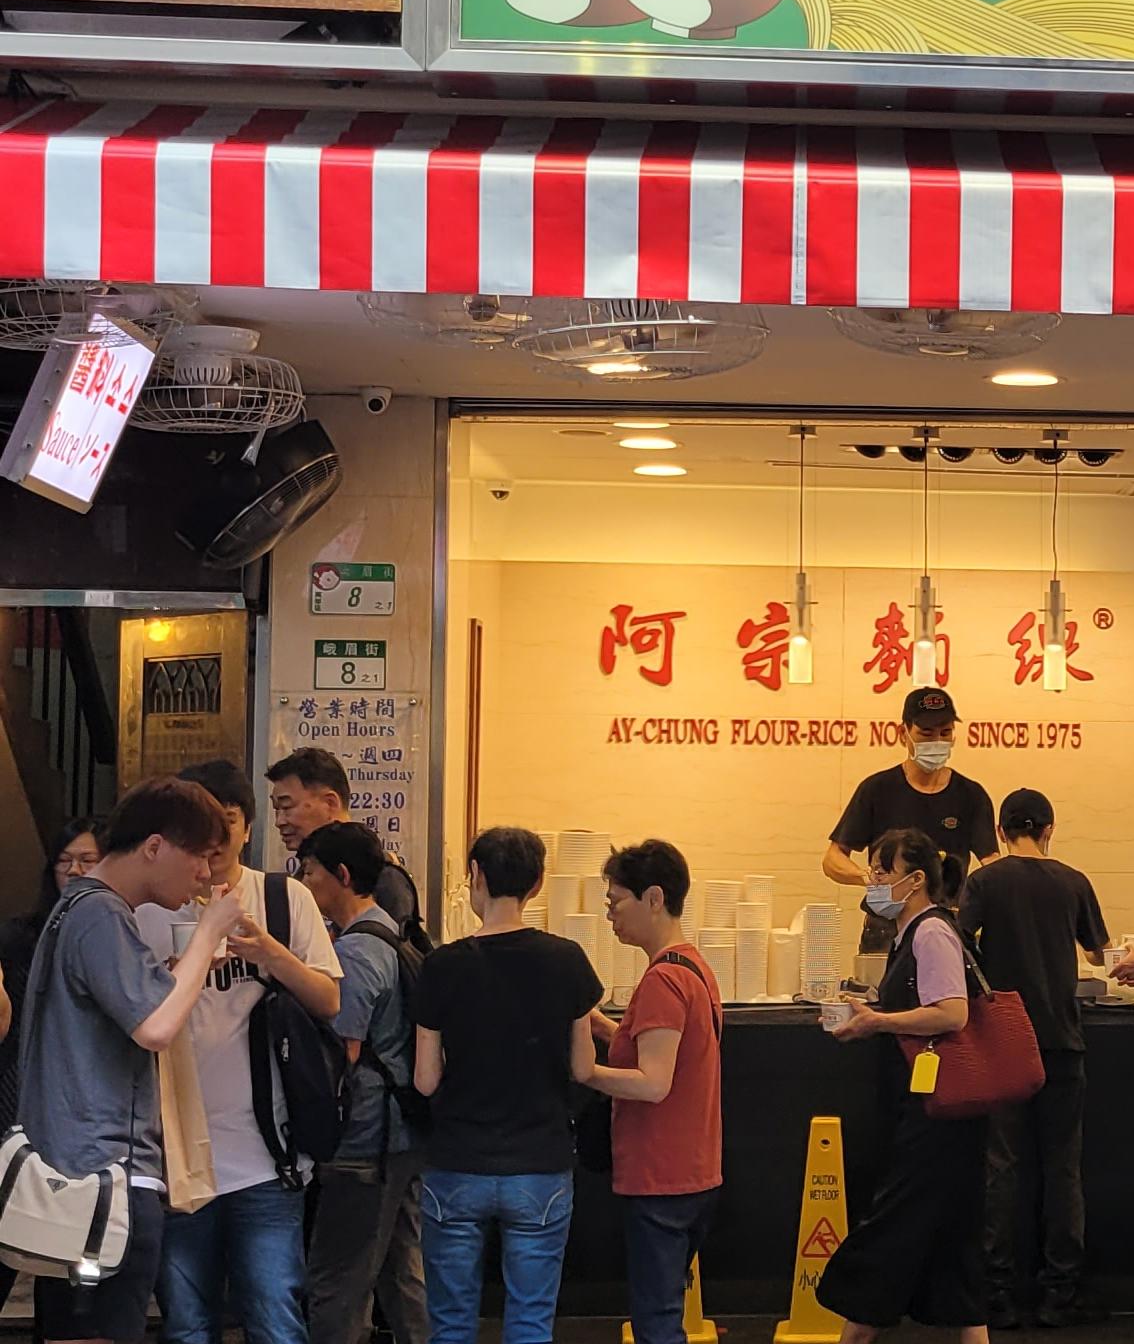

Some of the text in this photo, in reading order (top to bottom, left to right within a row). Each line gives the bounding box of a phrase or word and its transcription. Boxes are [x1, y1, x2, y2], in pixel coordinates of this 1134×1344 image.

[40, 411, 80, 467] Sauce
[347, 586, 362, 607] 8
[321, 641, 380, 657] 峨眉街
[340, 661, 357, 685] 8
[298, 697, 396, 720] 營業時間
[298, 720, 396, 741] Open Hours
[606, 717, 720, 745] AY-CHUNG
[730, 719, 858, 747] FLOUR-RICE
[967, 722, 1030, 748] SINCE
[1036, 722, 1082, 749] 1975
[347, 768, 415, 783] Thursday
[350, 791, 406, 810] 22:30
[811, 1174, 838, 1186] CAUTION
